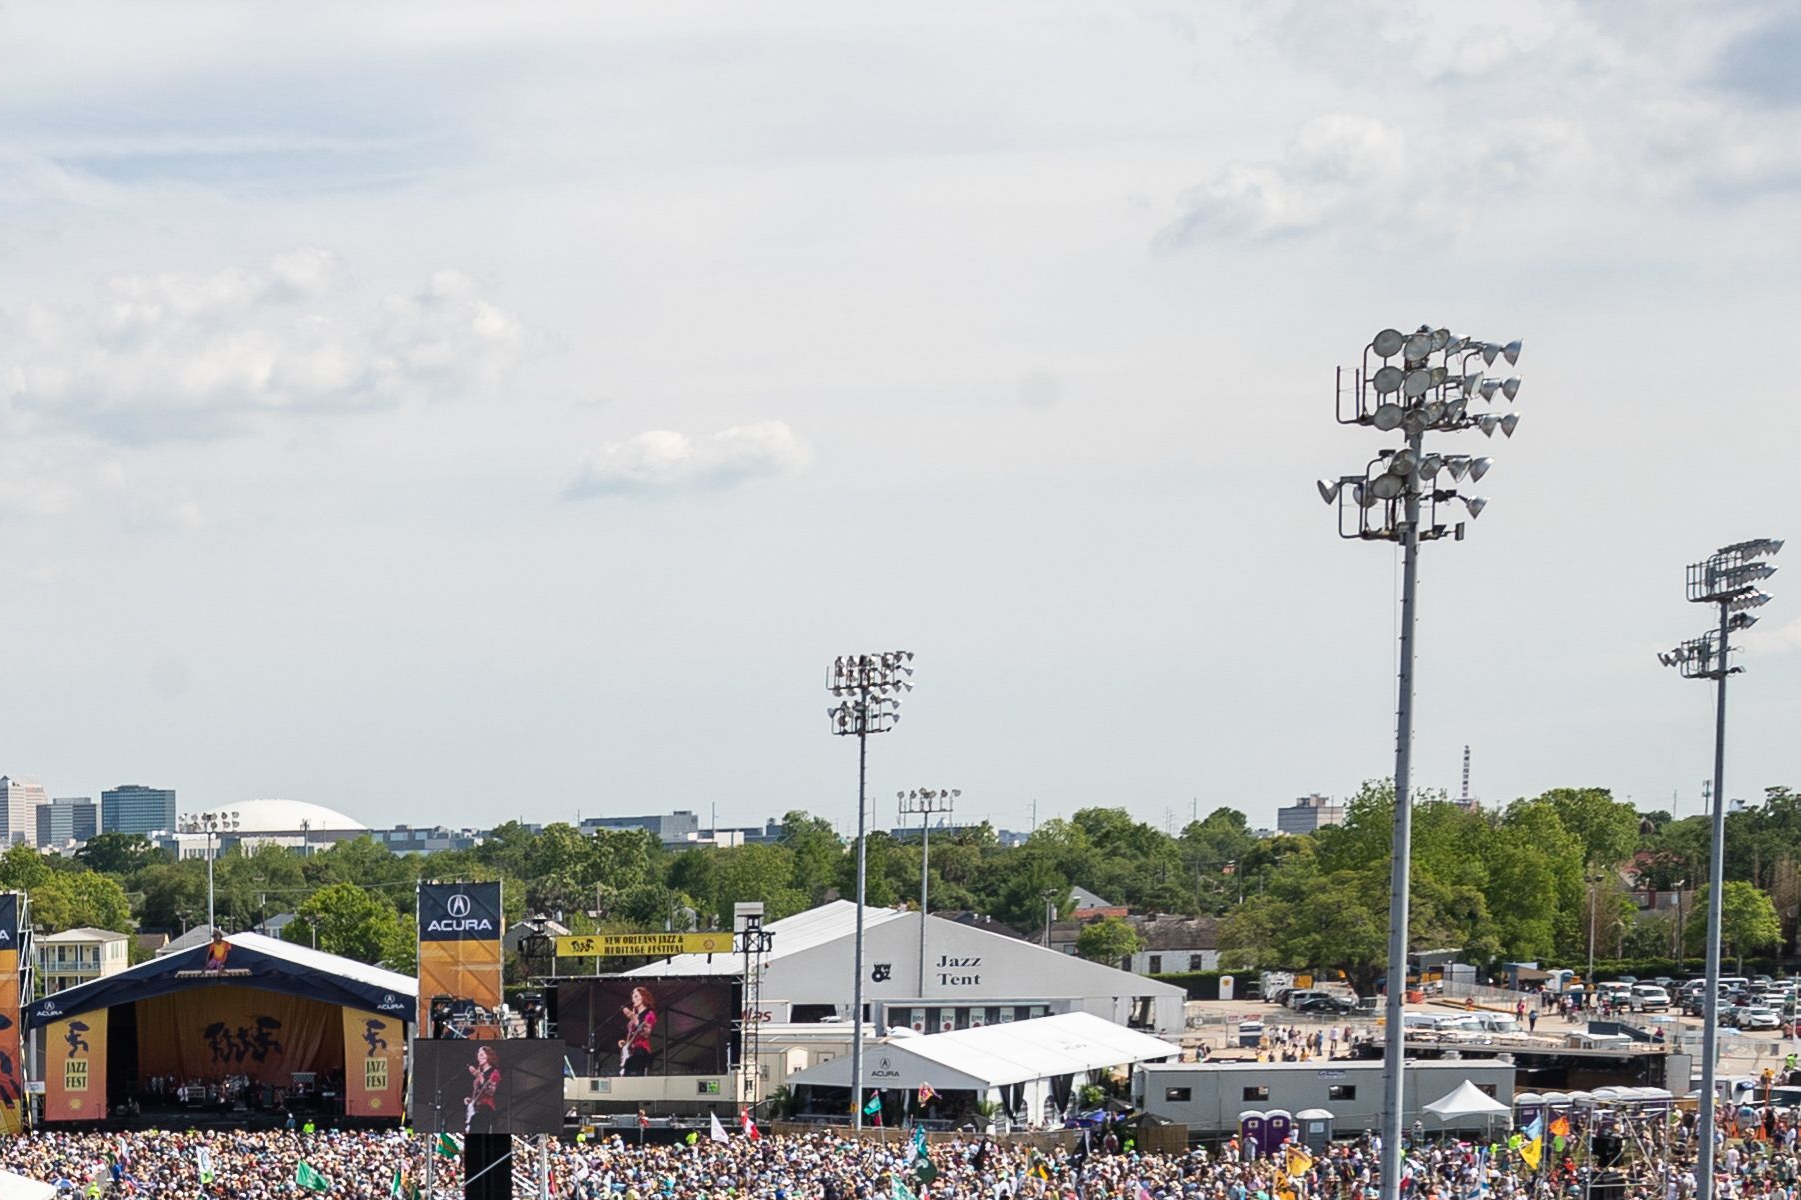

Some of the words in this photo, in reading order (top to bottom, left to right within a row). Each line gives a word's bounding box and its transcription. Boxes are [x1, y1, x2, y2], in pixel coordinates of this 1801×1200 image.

[427, 919, 493, 932] ACURA
[604, 936, 622, 945] NEW
[623, 935, 657, 944] ORLEANS
[658, 935, 676, 944] JAZZ
[677, 935, 684, 943] &
[604, 946, 645, 955] HERITAGE
[647, 945, 684, 954] FESTIVAL
[936, 955, 982, 967] Jazz
[936, 973, 982, 985] Tent
[66, 1061, 87, 1075] JAZZ
[366, 1060, 387, 1074] JAZZ
[871, 1070, 900, 1078] ACURA
[65, 1076, 87, 1088] FEST
[366, 1075, 386, 1088] FEST
